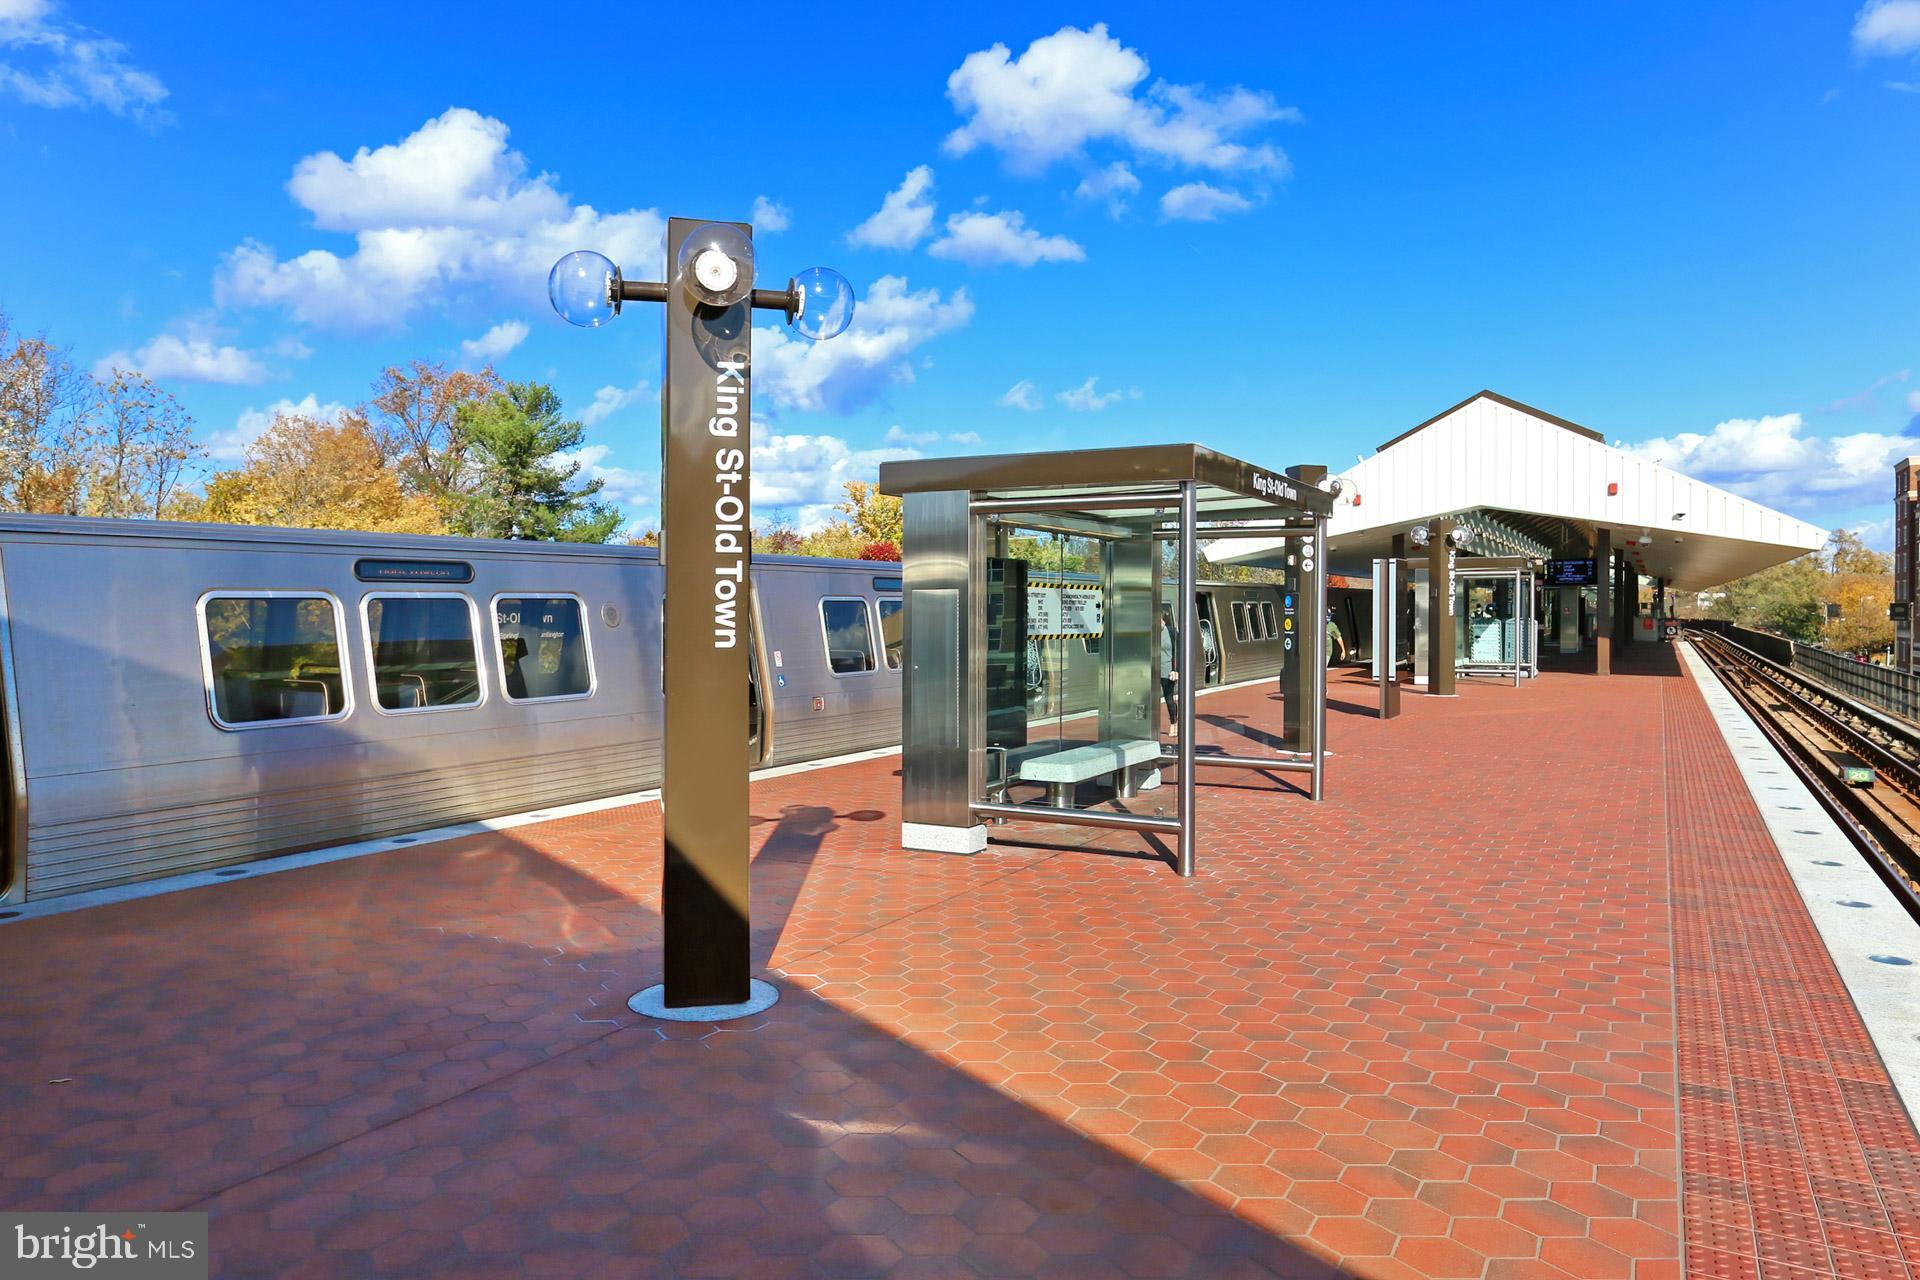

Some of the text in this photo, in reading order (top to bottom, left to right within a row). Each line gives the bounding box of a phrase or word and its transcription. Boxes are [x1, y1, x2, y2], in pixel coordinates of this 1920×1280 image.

[1253, 472, 1297, 501] King St-Old Town
[709, 361, 745, 649] King St-Old Town
[1448, 550, 1456, 569] King
[1448, 595, 1456, 616] Town
[1850, 771, 1868, 780] 20
